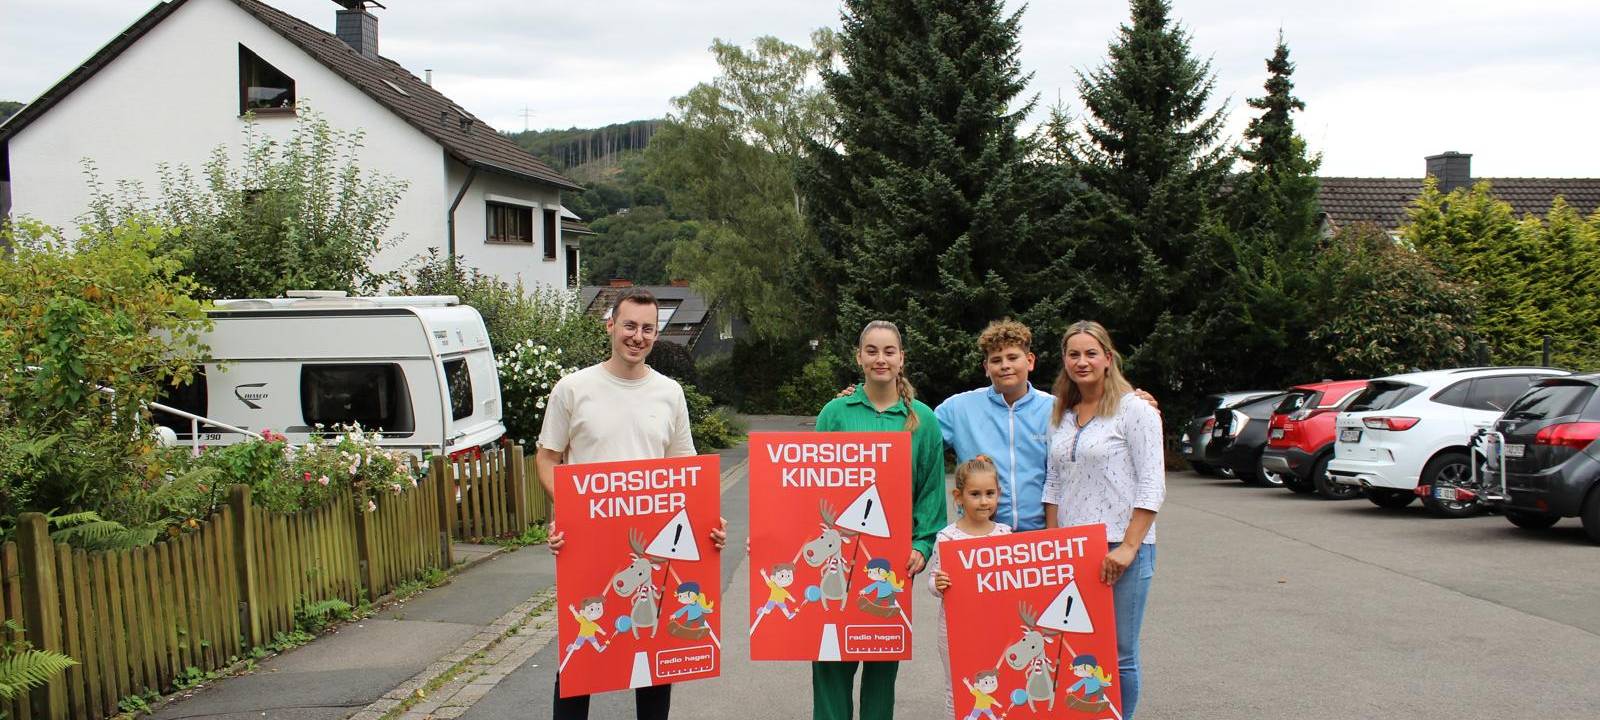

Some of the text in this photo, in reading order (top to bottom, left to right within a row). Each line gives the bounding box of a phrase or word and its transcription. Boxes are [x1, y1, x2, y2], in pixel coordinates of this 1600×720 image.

[205, 433, 221, 441] 390
[766, 443, 892, 463] VORSICHT
[572, 466, 702, 495] VORSICHT
[782, 467, 876, 487] KINDER
[589, 492, 686, 519] KINDER
[958, 536, 1088, 570] VORSICHT
[976, 563, 1075, 593] KINDER
[659, 654, 710, 665] radio hagen
